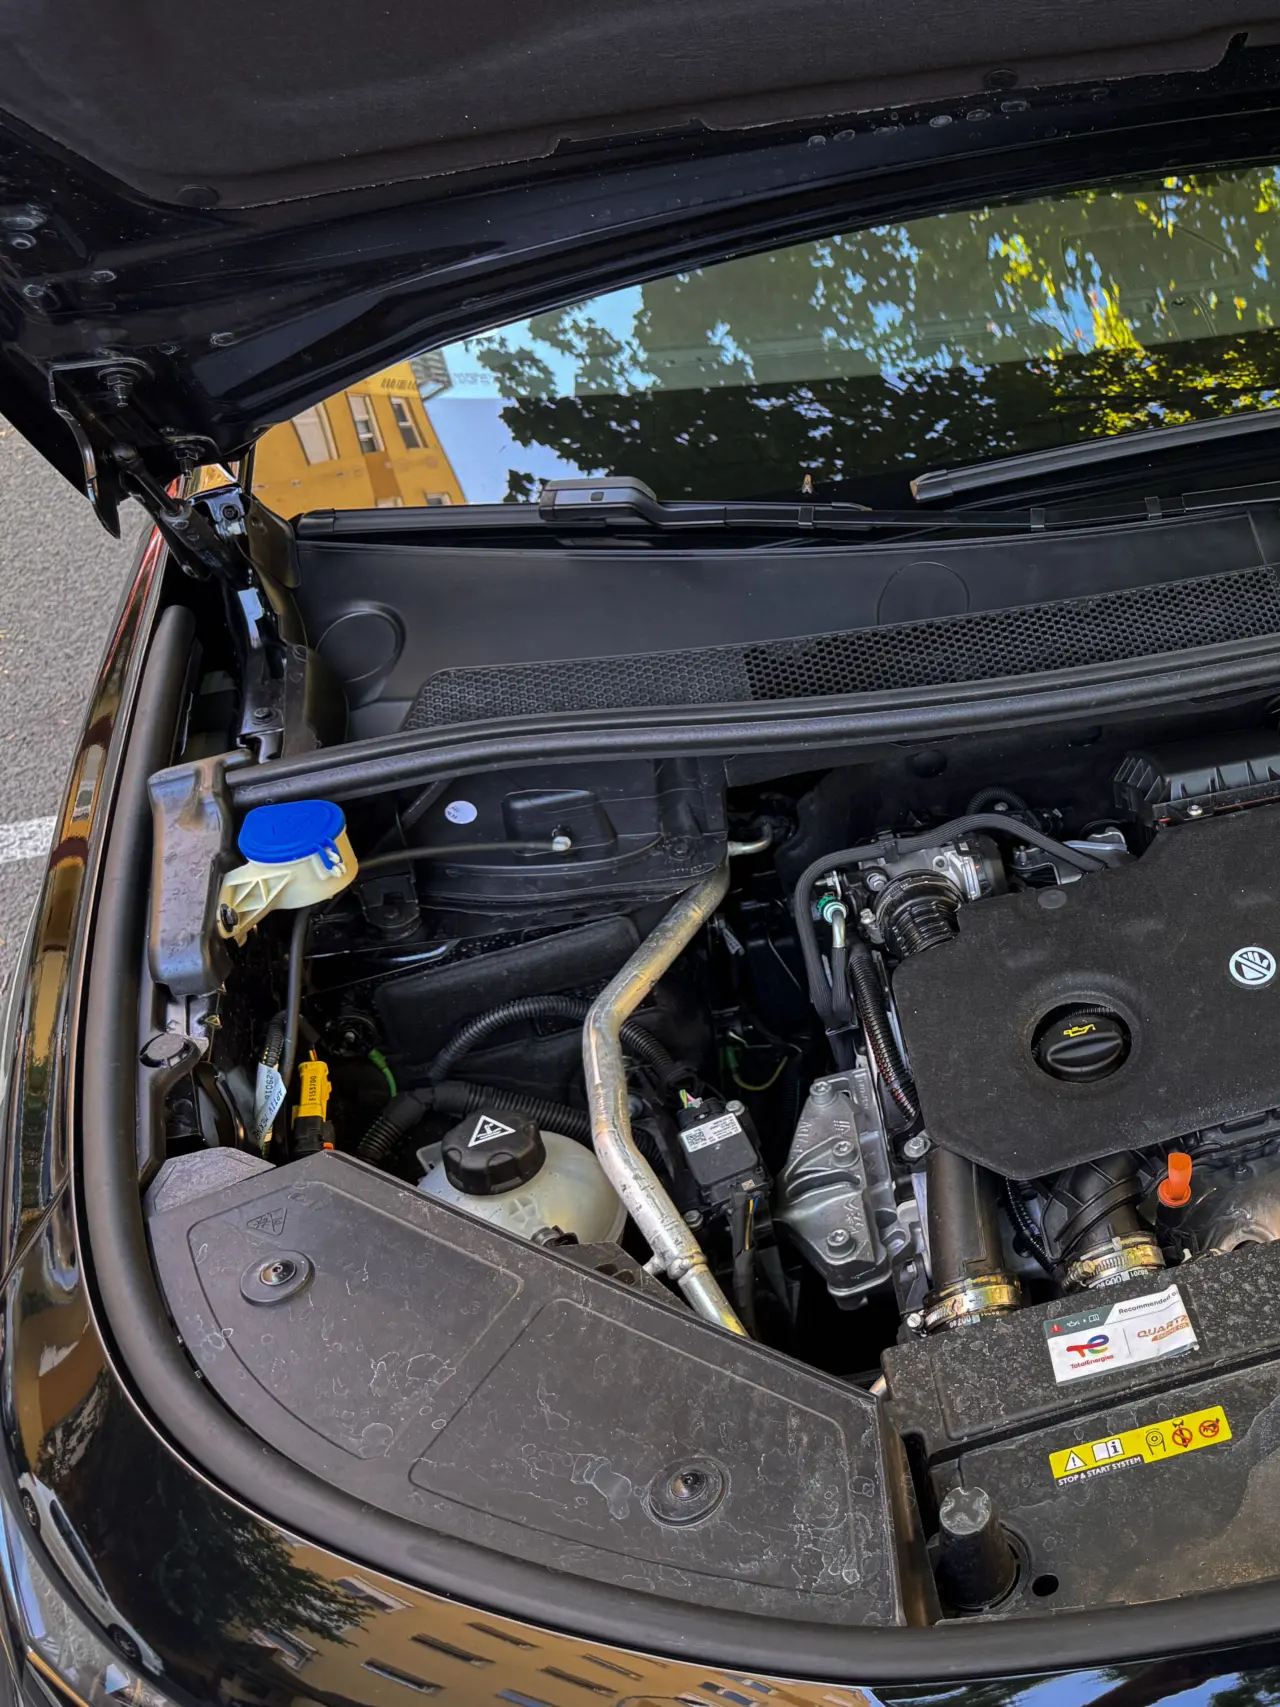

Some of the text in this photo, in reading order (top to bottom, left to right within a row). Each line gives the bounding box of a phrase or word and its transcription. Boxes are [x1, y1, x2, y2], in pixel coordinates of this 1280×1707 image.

[268, 1088, 283, 1115] APTIV
[1118, 1295, 1171, 1315] Recommended
[1137, 1315, 1188, 1338] QUARTZ
[1070, 1354, 1115, 1370] TotalEnergies
[1058, 1474, 1080, 1487] STOP
[1086, 1465, 1112, 1479] START
[1113, 1456, 1142, 1471] SYSTEM
